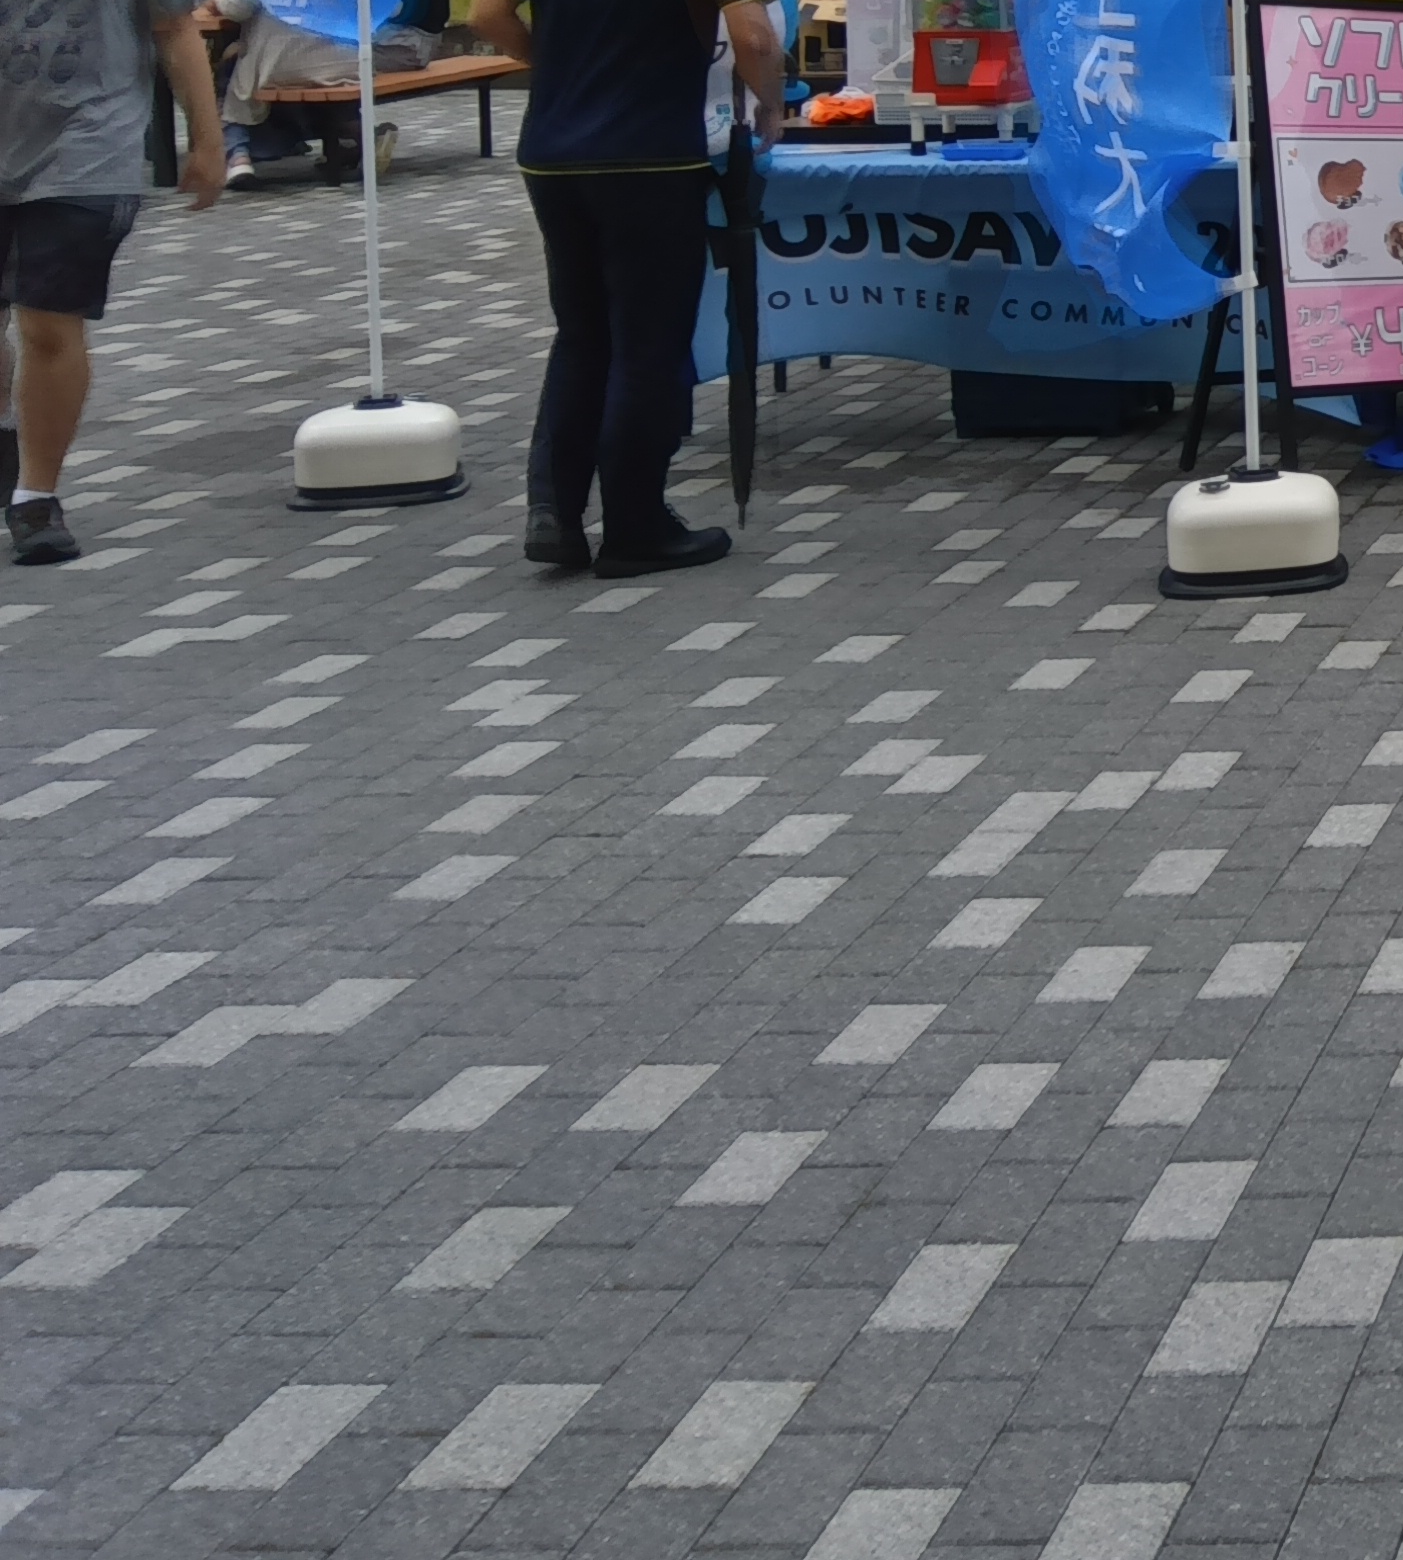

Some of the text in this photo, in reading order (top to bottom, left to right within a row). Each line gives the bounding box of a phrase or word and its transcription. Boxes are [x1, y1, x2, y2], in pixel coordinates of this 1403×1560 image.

[768, 286, 970, 318] OLUNTEER
[1297, 301, 1342, 327] カップ
[1308, 334, 1334, 348] or
[1302, 356, 1345, 377] コーン
